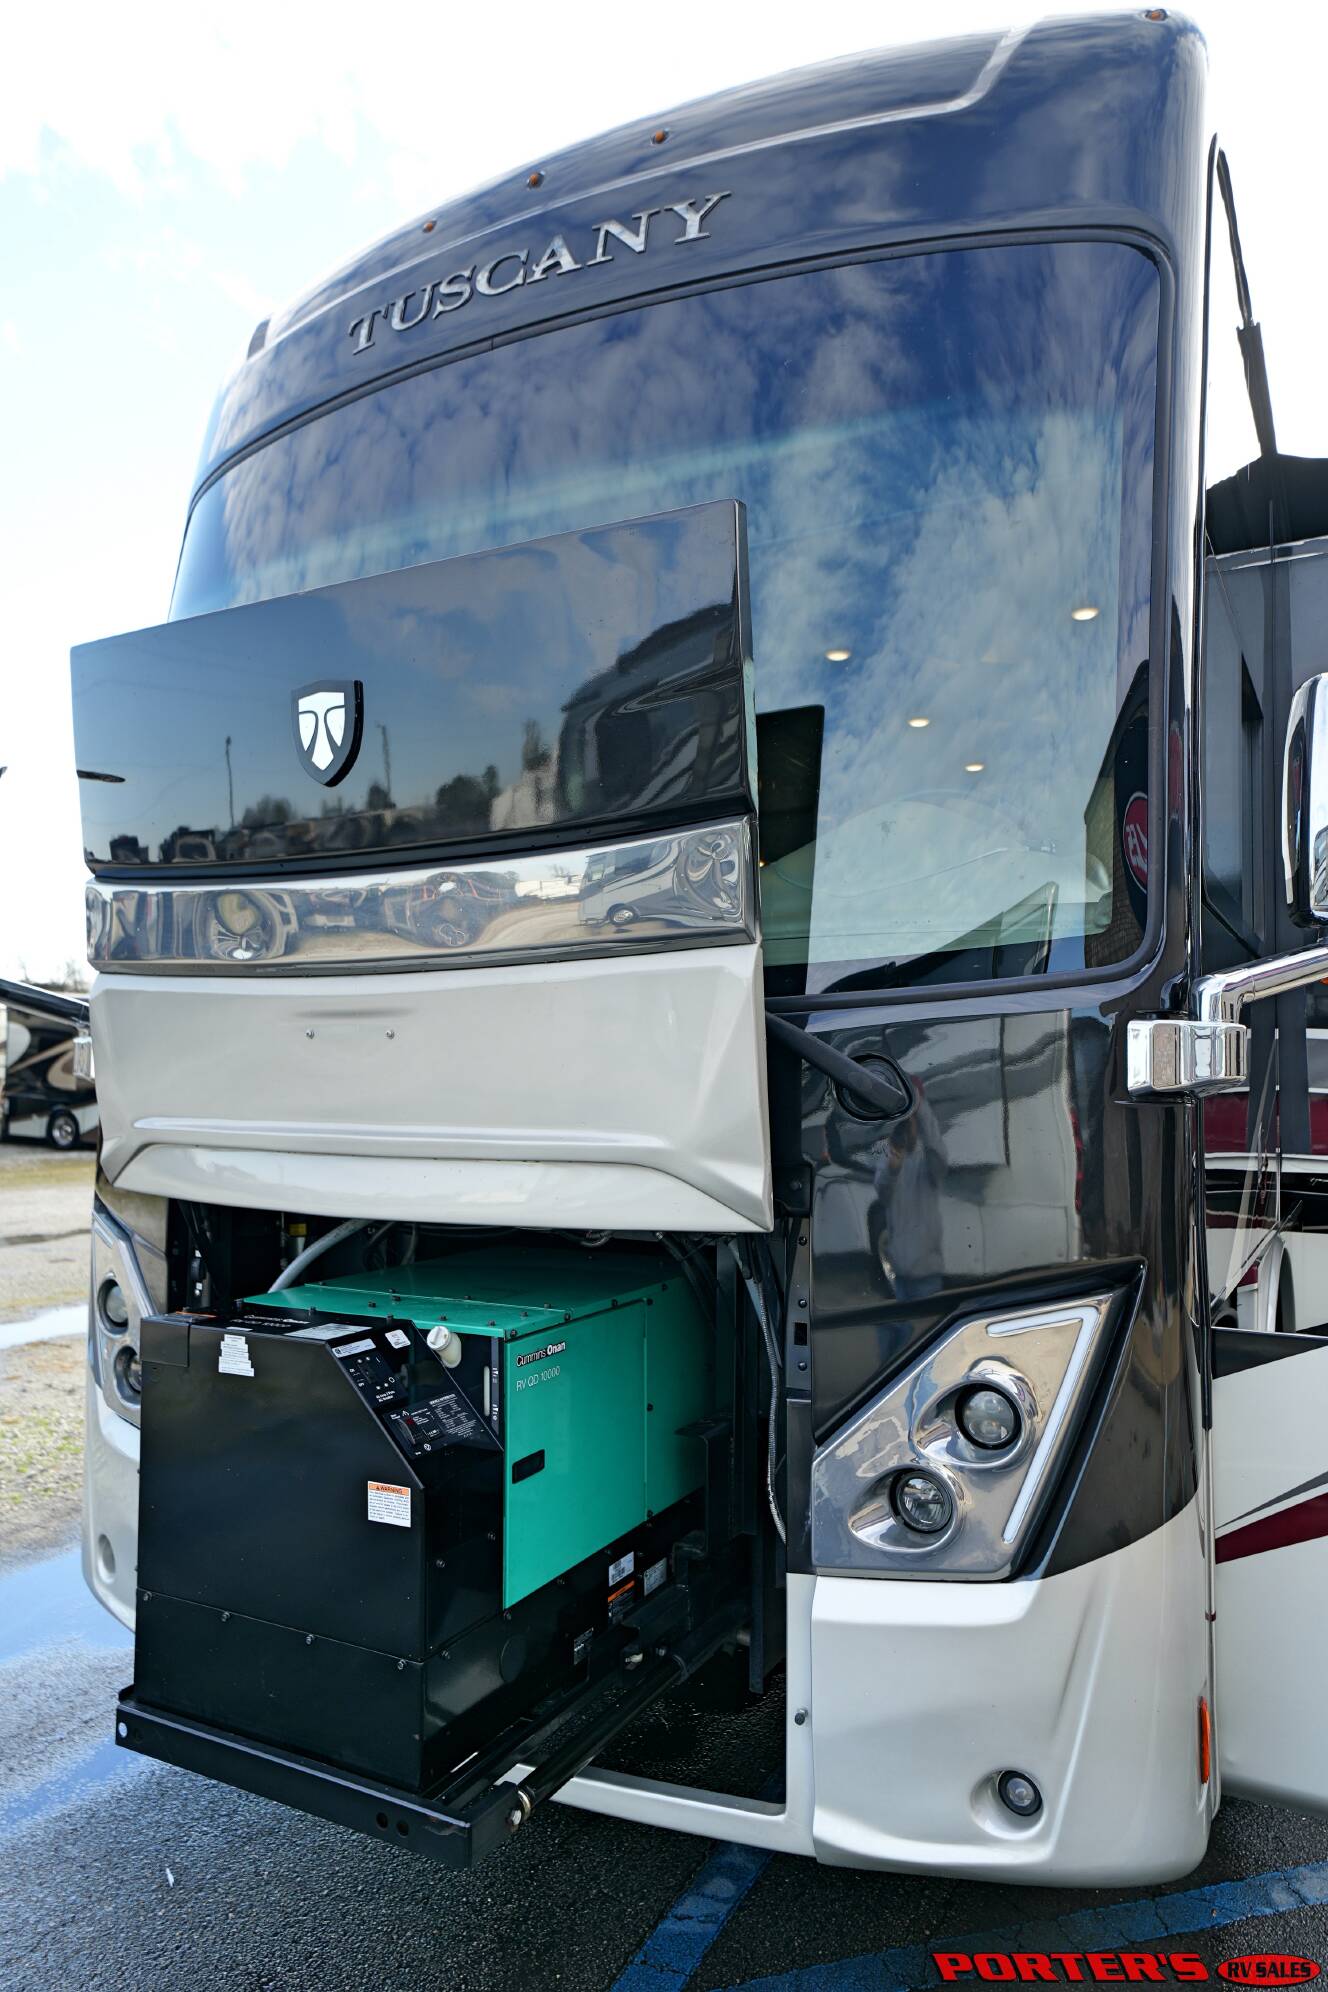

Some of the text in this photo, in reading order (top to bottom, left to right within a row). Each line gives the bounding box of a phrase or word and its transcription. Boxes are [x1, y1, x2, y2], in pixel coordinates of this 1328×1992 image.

[348, 190, 732, 356] TUSCANY
[516, 1341, 567, 1367] Cummins Onan
[516, 1365, 561, 1392] RV QD 10000
